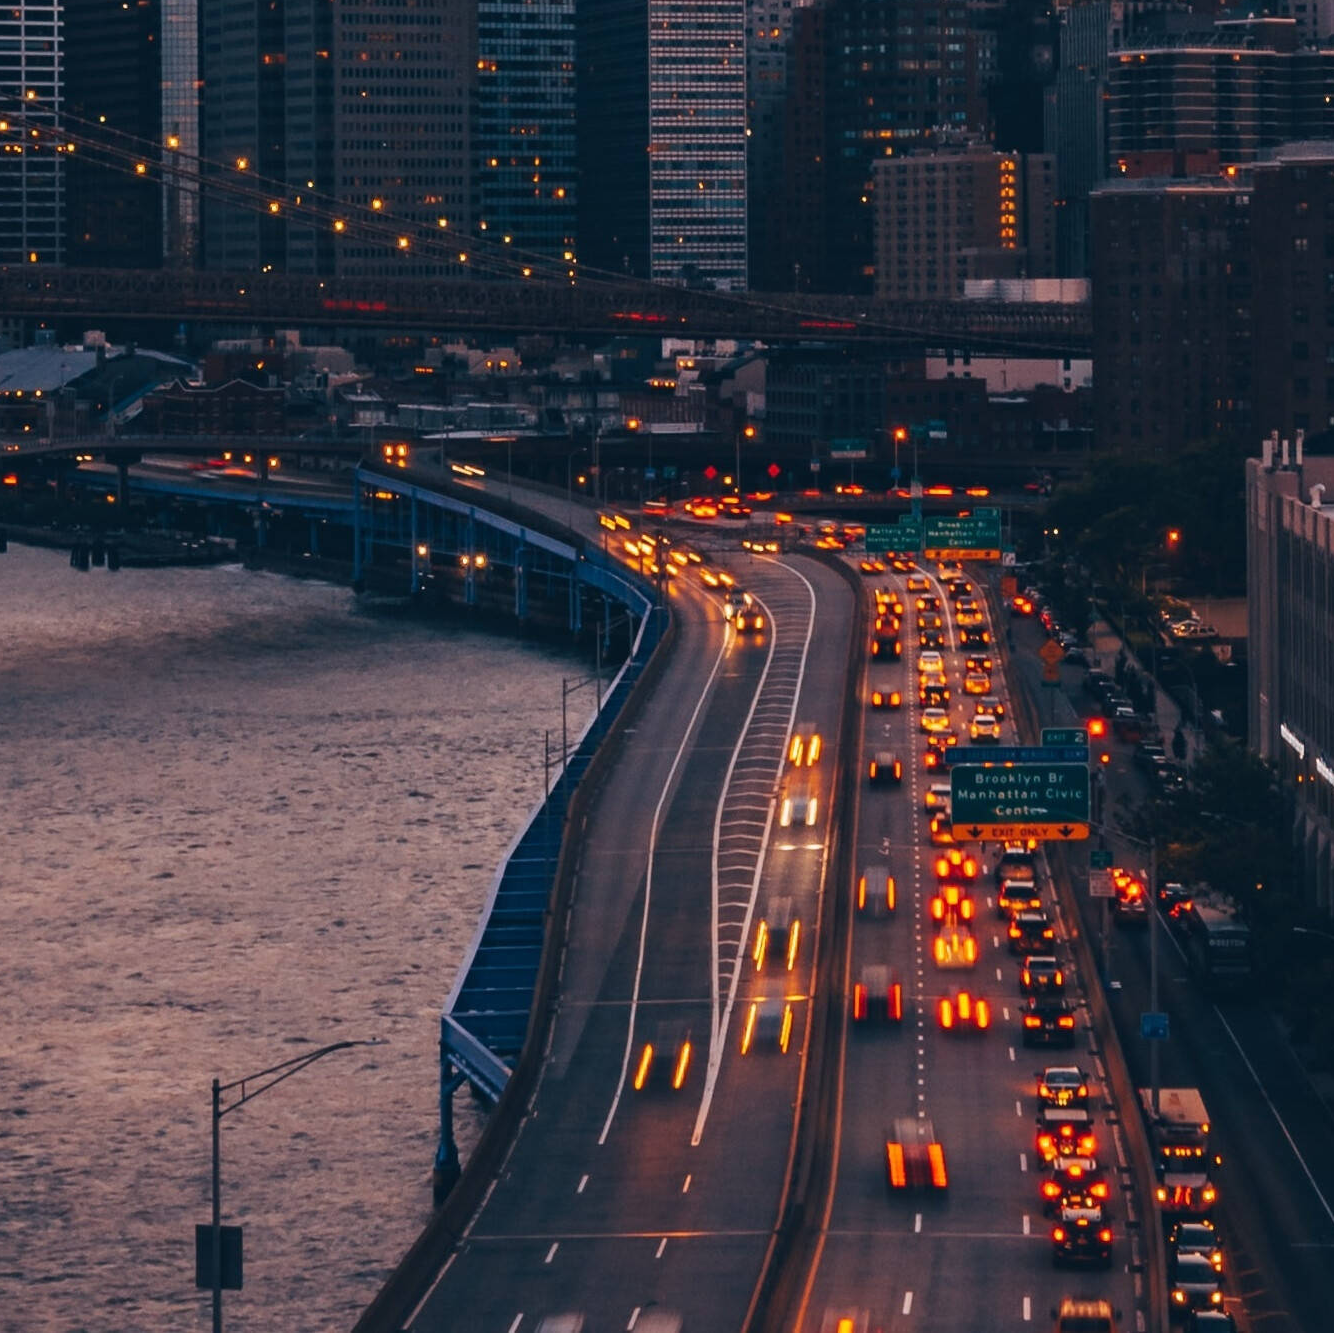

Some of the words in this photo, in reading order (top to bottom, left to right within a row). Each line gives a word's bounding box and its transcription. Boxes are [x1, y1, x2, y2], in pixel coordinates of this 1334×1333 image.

[1074, 732, 1084, 743] 2
[975, 773, 1041, 785] Brooklyn
[1048, 772, 1064, 783] Br
[957, 789, 1038, 800] Manhattan
[1045, 788, 1083, 799] Civic
[992, 827, 1014, 837] EXIT
[1020, 827, 1049, 837] ONLY
